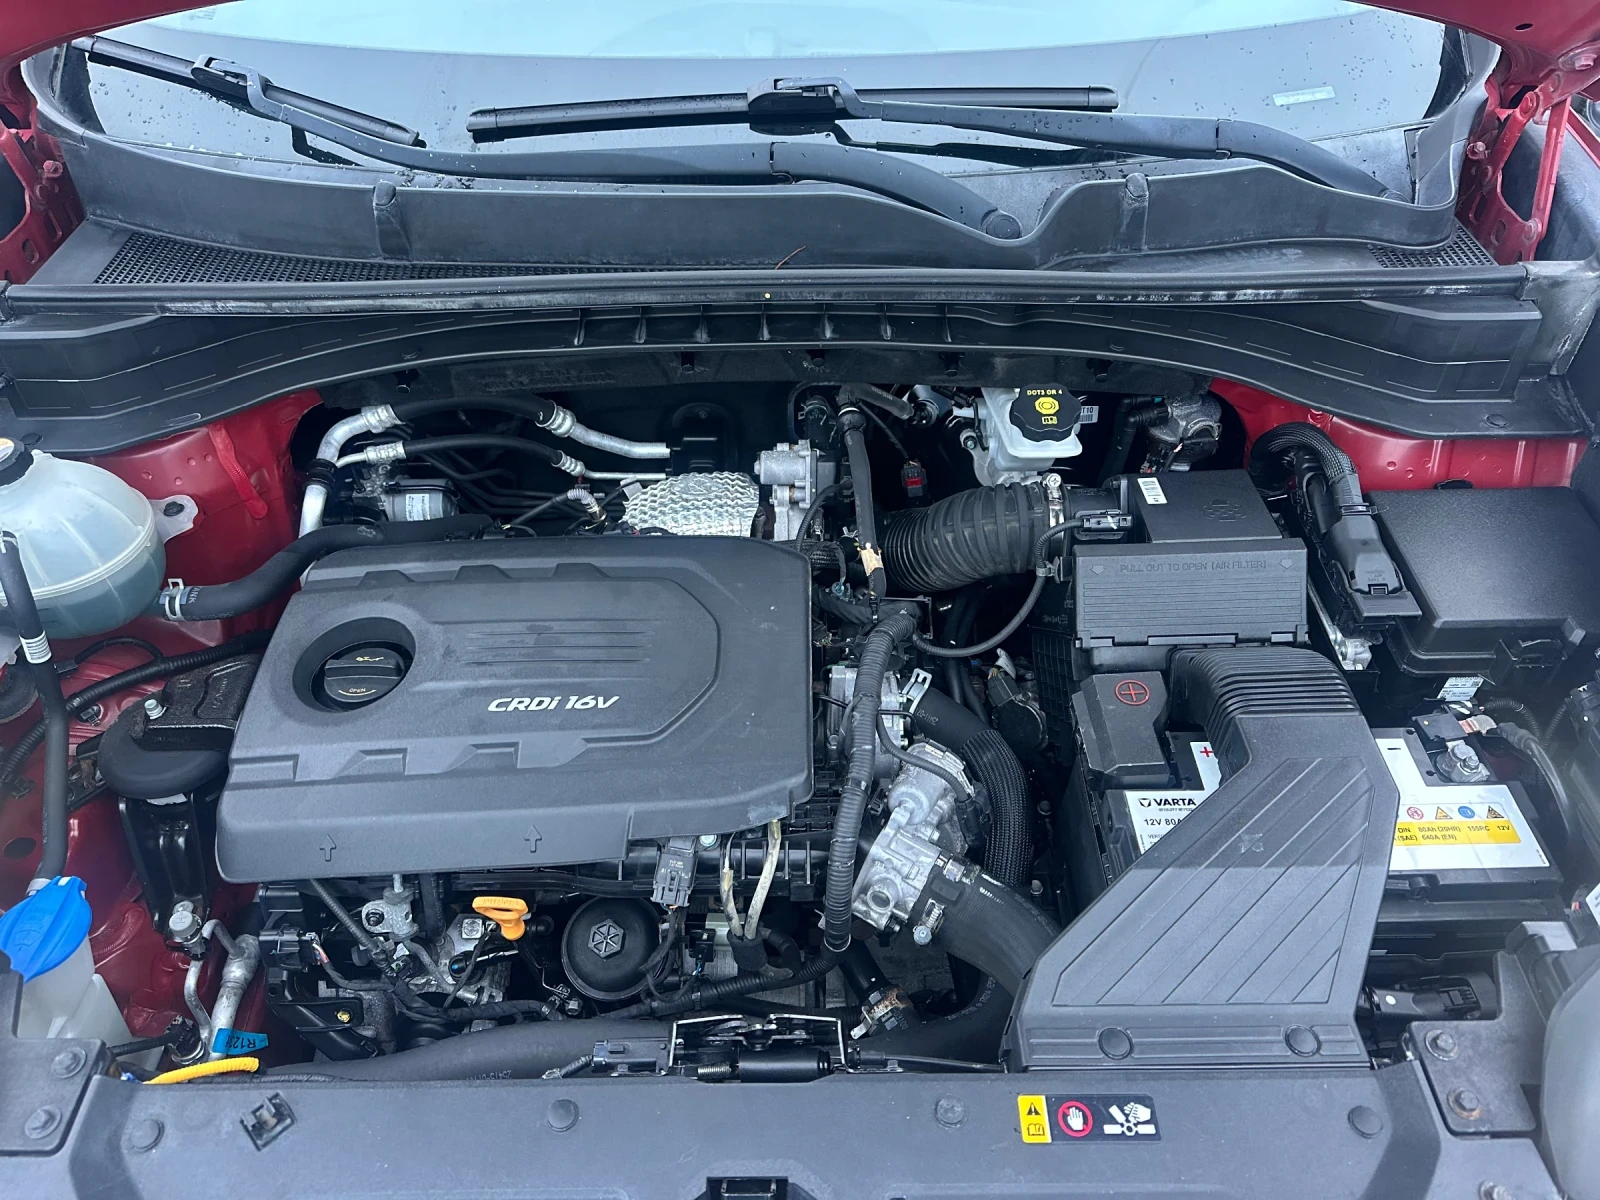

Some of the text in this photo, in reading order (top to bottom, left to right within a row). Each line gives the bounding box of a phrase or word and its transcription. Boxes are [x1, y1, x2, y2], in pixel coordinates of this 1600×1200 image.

[1120, 564, 1143, 572] PULL
[1145, 563, 1163, 572] OUT
[1167, 563, 1180, 571] TO
[1182, 562, 1207, 571] OPEN
[487, 695, 620, 712] CRDi 16V
[1153, 798, 1197, 806] VARTA
[1144, 818, 1162, 826] 12V
